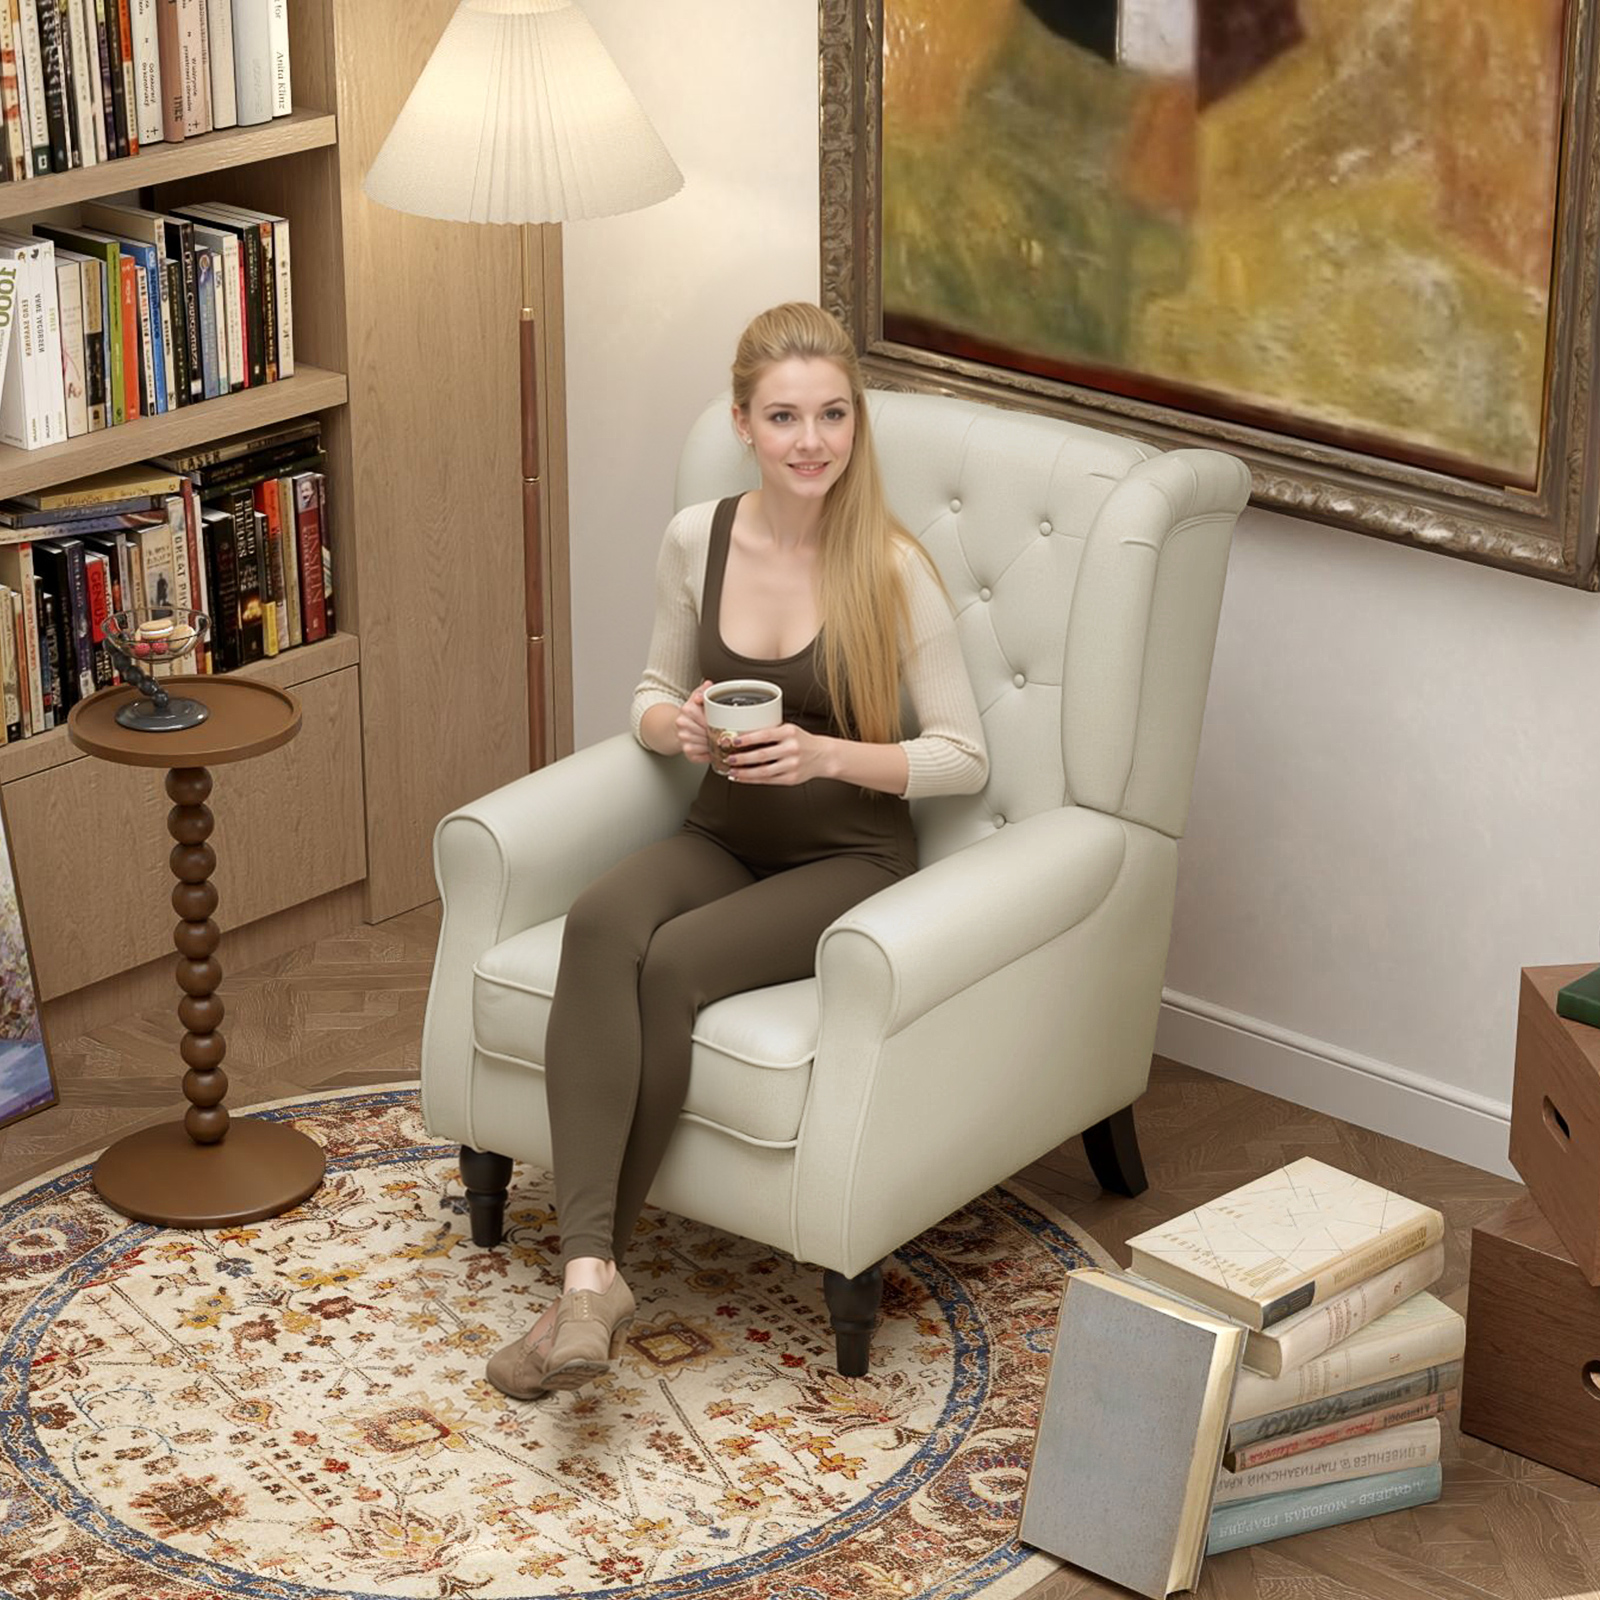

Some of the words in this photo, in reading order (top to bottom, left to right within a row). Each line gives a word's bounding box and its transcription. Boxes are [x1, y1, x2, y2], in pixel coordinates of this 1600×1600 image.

[275, 51, 285, 79] Anita
[276, 82, 287, 110] Klinz
[179, 450, 221, 474] LASER
[234, 501, 246, 558] RHODES
[174, 536, 186, 577] GREAT
[308, 523, 322, 604] EINSTEIN
[91, 571, 105, 626] GENIUS
[1247, 1462, 1337, 1487] ПАРТИЗАНСКИЙ
[1285, 1498, 1348, 1524] МОЛОДАЯ
[1219, 1515, 1279, 1538] ГВАРДИЯ
